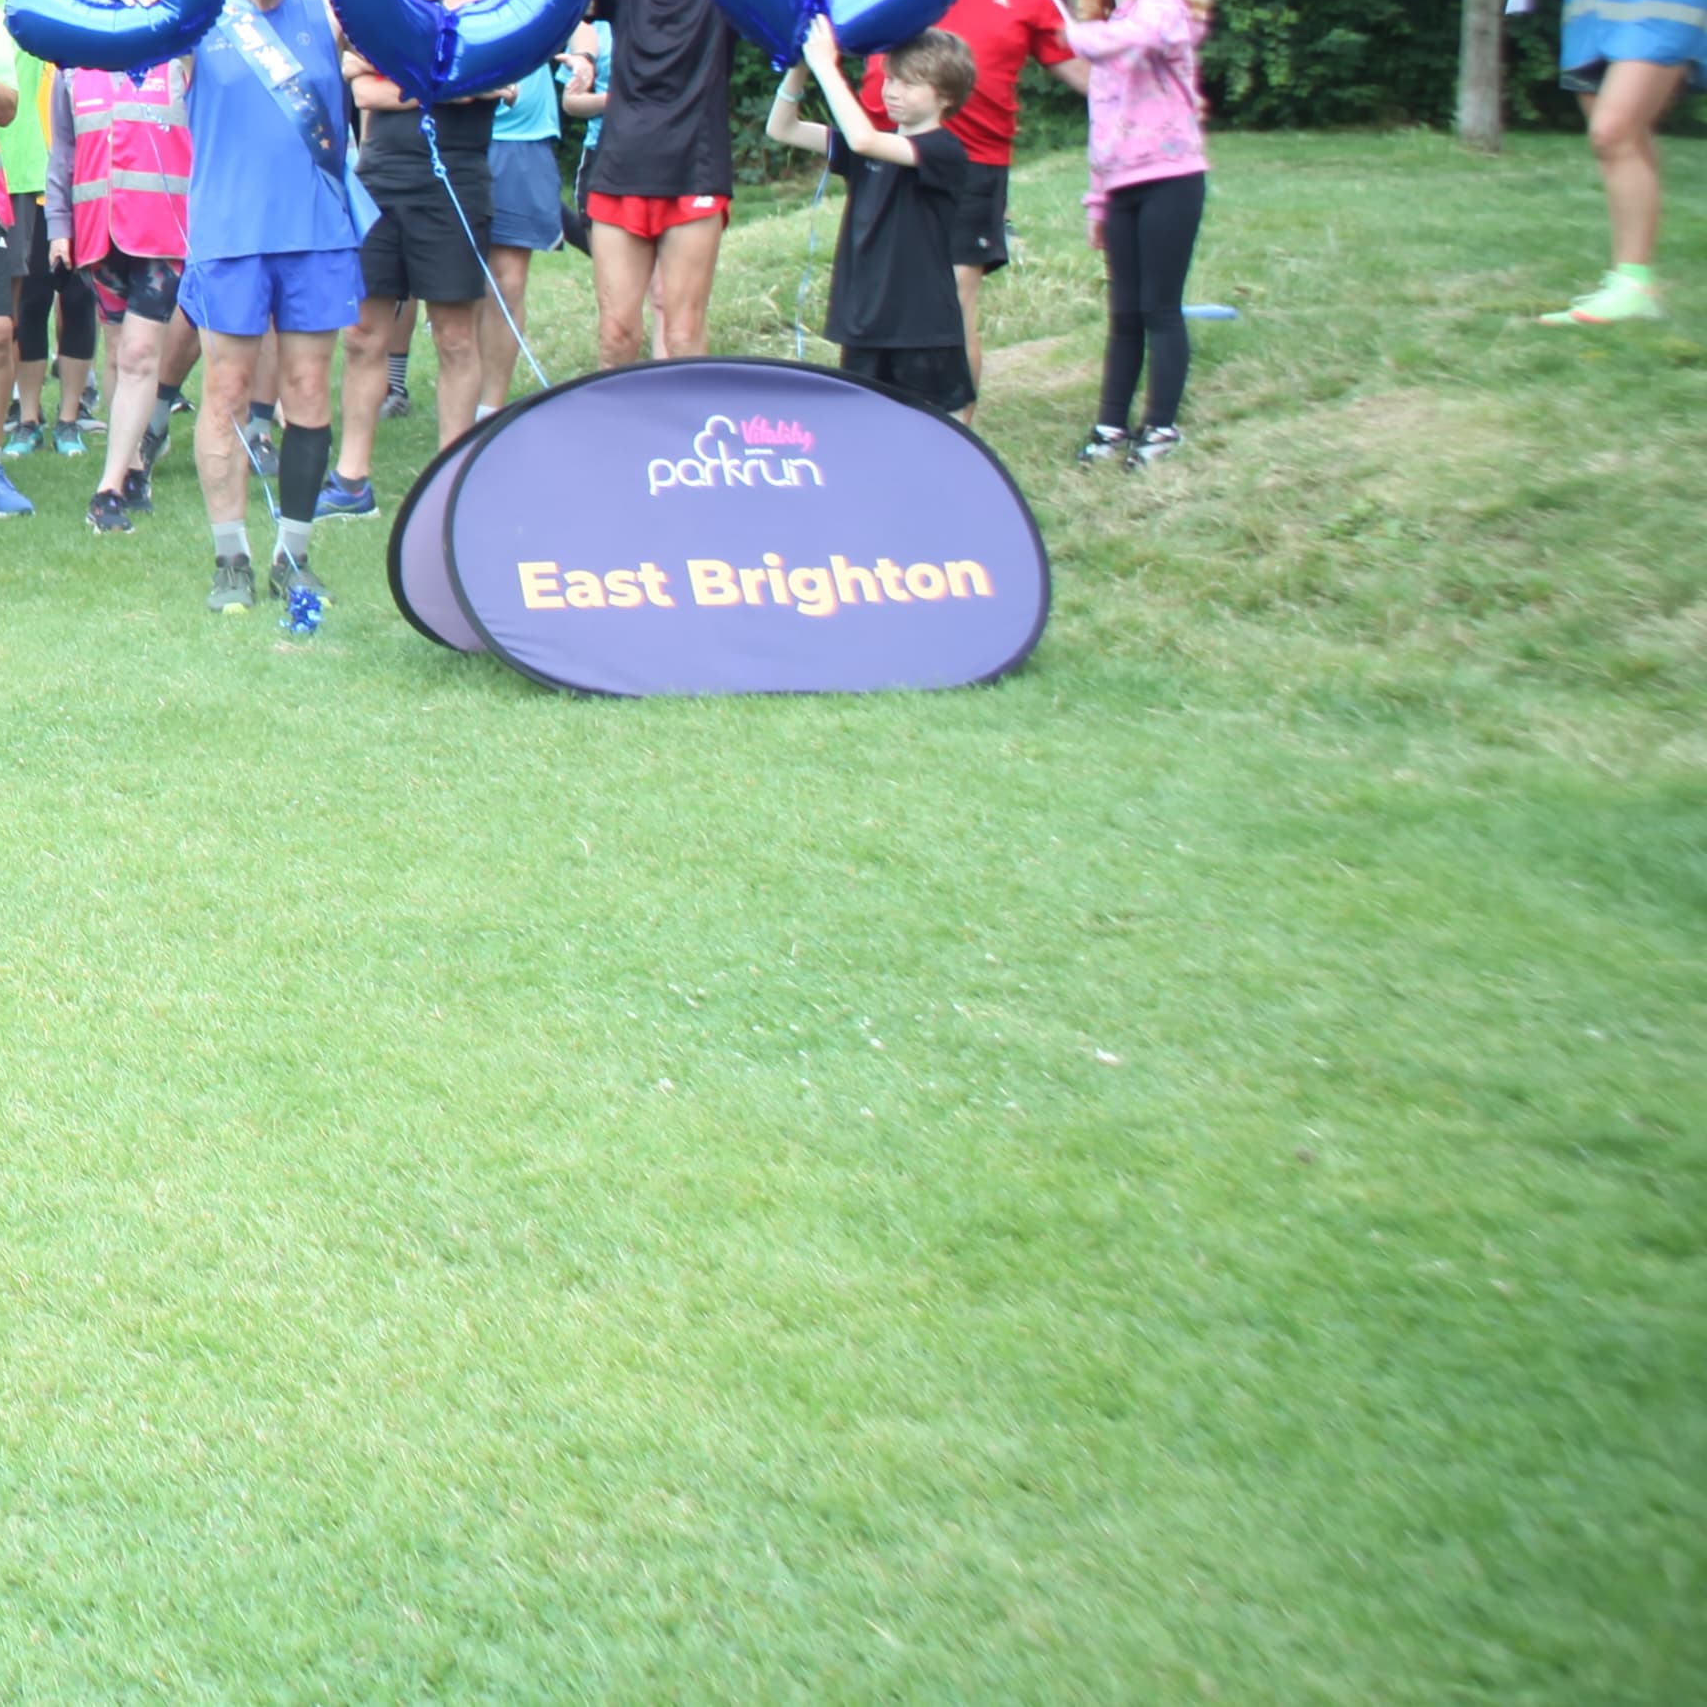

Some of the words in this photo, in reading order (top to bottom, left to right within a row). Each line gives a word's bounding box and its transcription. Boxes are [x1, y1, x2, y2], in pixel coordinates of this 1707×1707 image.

[740, 414, 815, 452] Vitality
[648, 439, 825, 495] parkrun
[517, 561, 676, 610] East
[686, 552, 994, 618] Brighton
